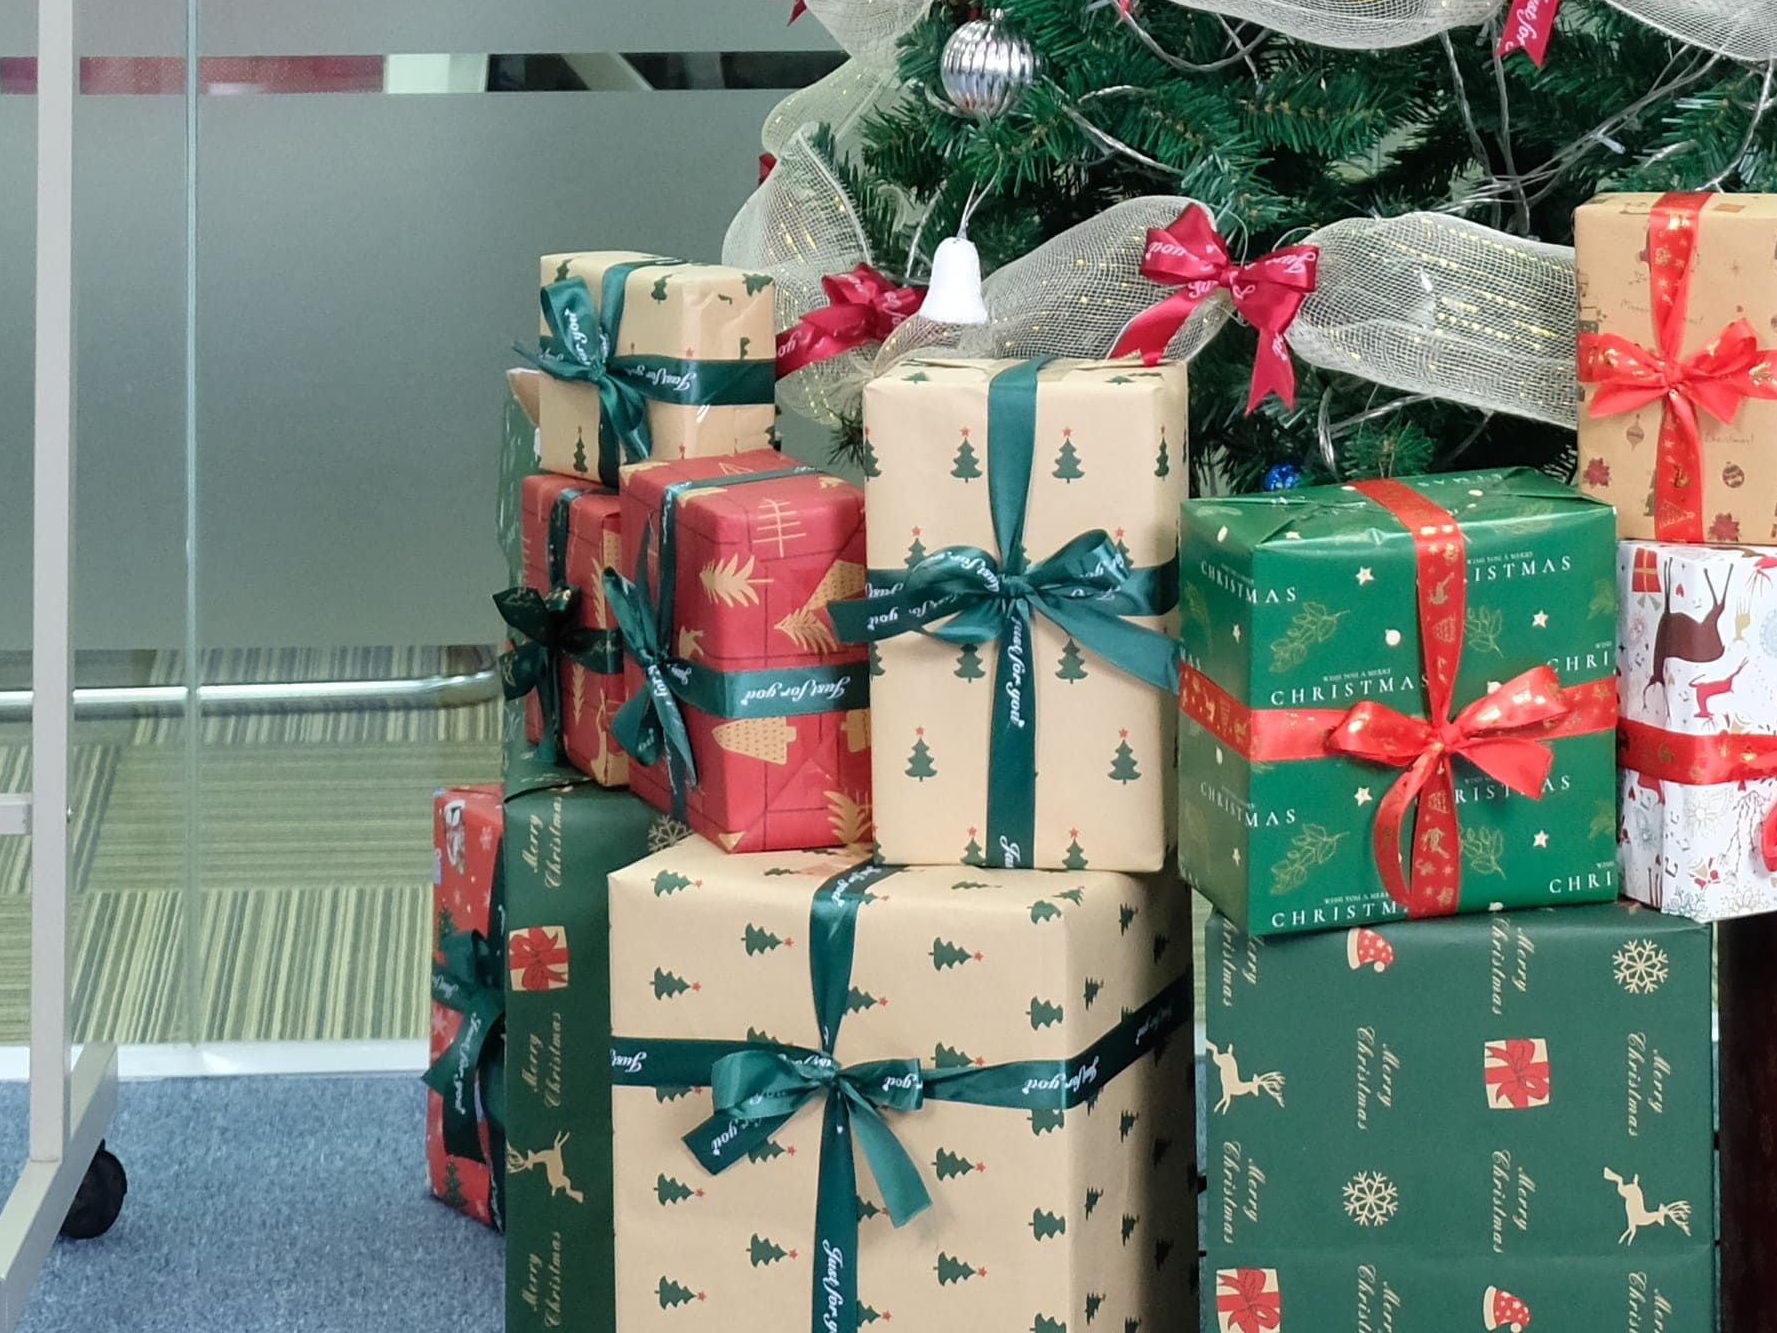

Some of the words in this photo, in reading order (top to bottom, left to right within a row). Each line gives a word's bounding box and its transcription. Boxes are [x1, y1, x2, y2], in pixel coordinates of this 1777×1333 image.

[568, 309, 587, 341] you
[660, 370, 694, 390] Just
[1201, 560, 1297, 604] CHRISTMAS
[1475, 555, 1571, 581] ISTMAS
[867, 608, 898, 629] you
[1007, 618, 1023, 654] Just
[780, 678, 812, 699] for
[805, 677, 850, 697] Just
[1007, 650, 1025, 684] for
[741, 682, 783, 704] you
[1006, 682, 1023, 727] you
[1200, 781, 1296, 827] CHRISTMAS
[523, 814, 539, 873] Merry
[1490, 916, 1510, 1015] Christmas
[1516, 927, 1536, 992] Merry
[524, 1033, 542, 1093] Merry
[544, 1011, 563, 1109] Christmas
[882, 1073, 918, 1090] you
[1357, 1025, 1376, 1130] Christmas
[1381, 1043, 1401, 1107] Merry
[1653, 1049, 1672, 1114] Merry
[453, 1075, 466, 1115] you
[1022, 1073, 1067, 1094] you
[1627, 1032, 1647, 1137] Christmas
[1223, 1140, 1242, 1244] Christmas
[1247, 1158, 1267, 1223] Merry
[1491, 1149, 1512, 1254] Christmas
[1517, 1167, 1536, 1232] Merry
[544, 1230, 563, 1332] Christmas
[823, 1239, 843, 1288] Just
[823, 1280, 843, 1317] for
